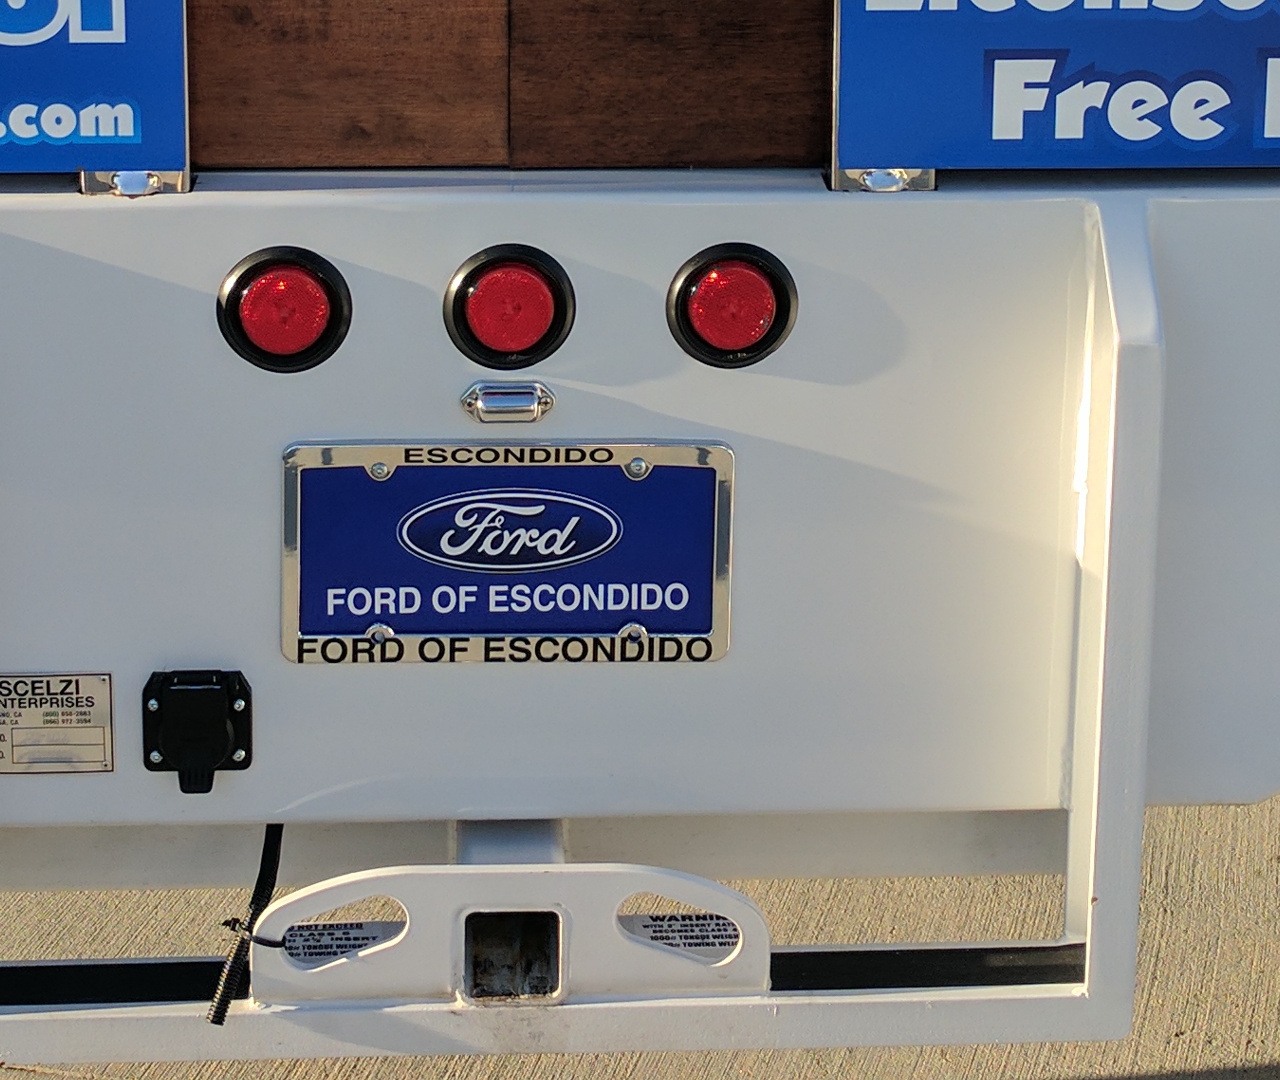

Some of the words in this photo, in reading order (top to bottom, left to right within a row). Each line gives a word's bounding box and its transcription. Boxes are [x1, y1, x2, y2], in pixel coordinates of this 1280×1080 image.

[991, 58, 1226, 142] Free
[403, 447, 615, 464] ESCONDIDO
[439, 501, 581, 557] Ford
[326, 586, 422, 616] FORD
[431, 585, 478, 614] OF
[488, 582, 690, 613] ESCONDIDO
[296, 637, 406, 665] FORD
[418, 637, 472, 664] OF
[483, 636, 714, 664] ESCONDIDO
[648, 914, 732, 923] WARNIN
